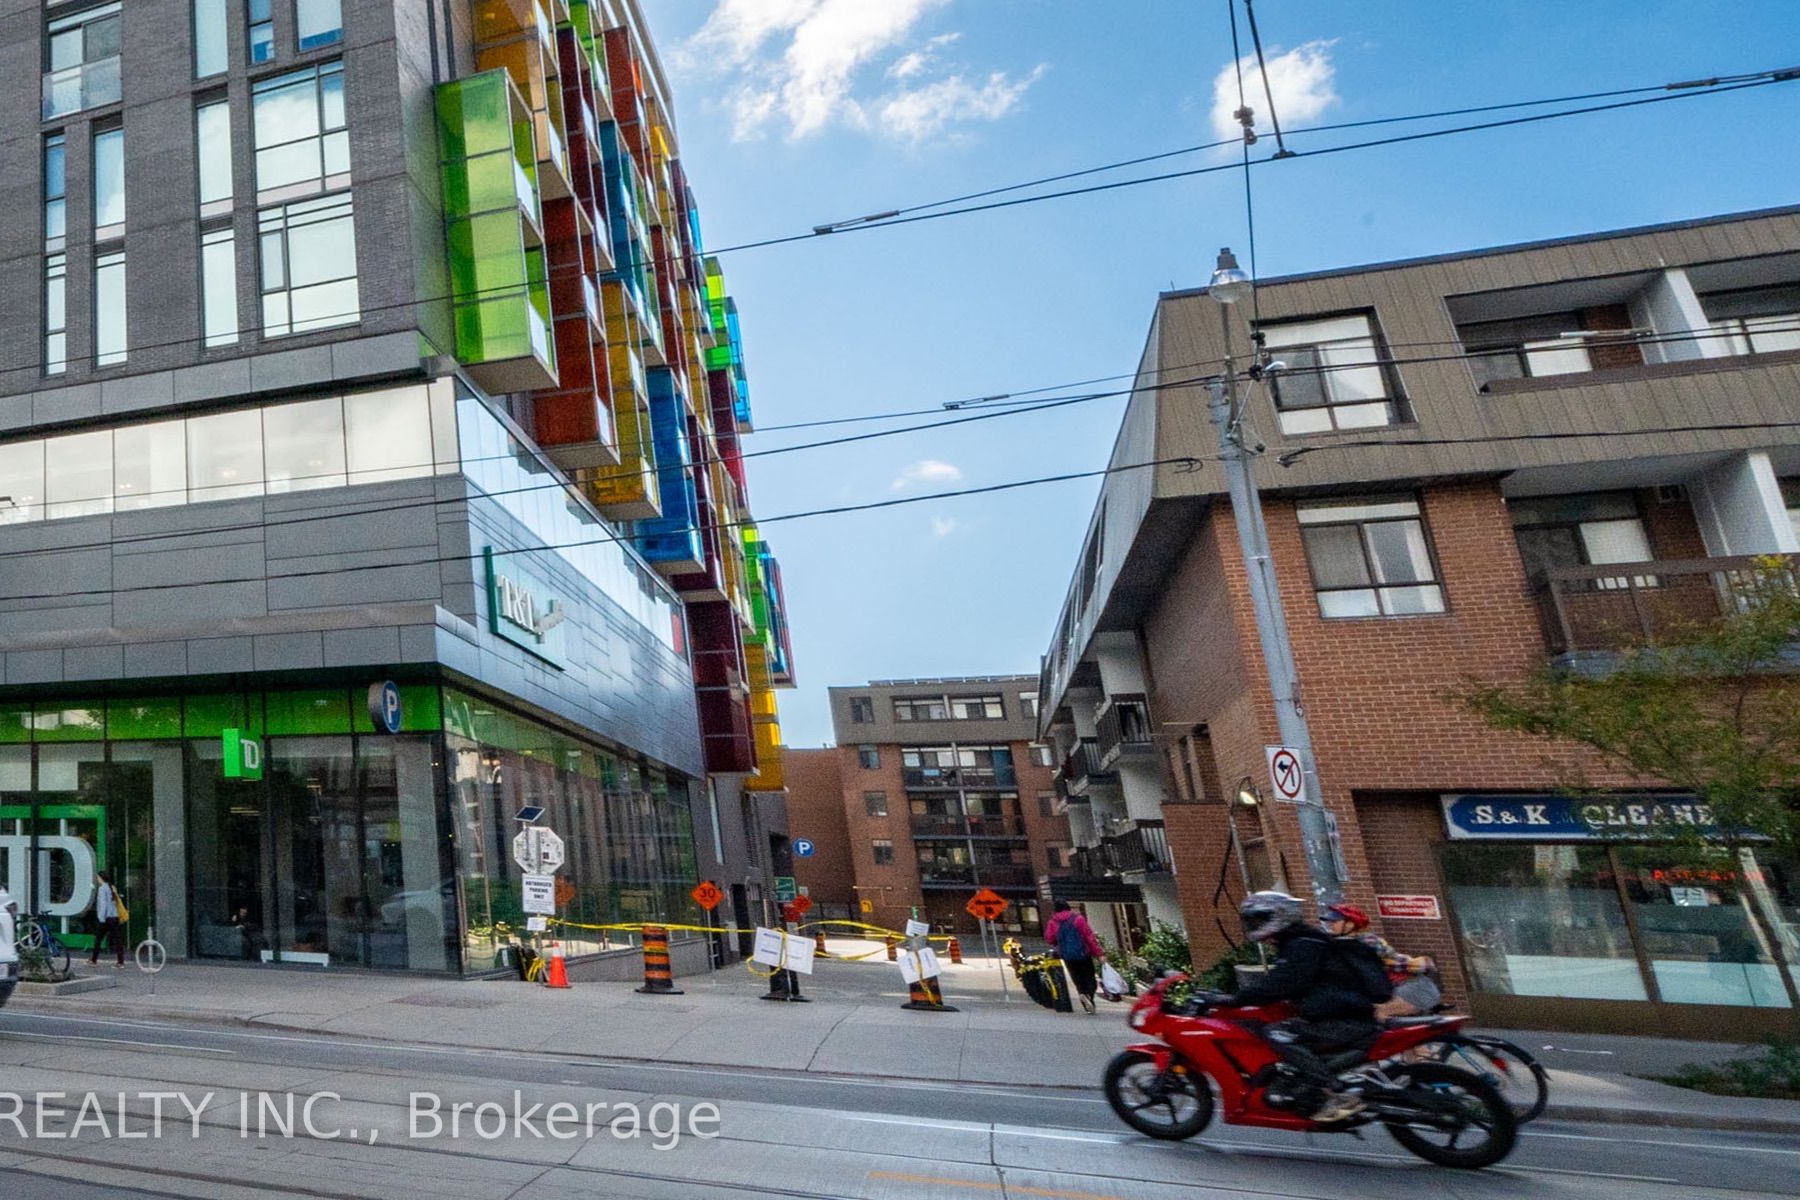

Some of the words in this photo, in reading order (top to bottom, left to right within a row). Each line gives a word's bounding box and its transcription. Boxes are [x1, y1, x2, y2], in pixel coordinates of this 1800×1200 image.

[494, 575, 536, 633] T&T
[386, 690, 398, 724] P
[240, 738, 260, 770] TD
[799, 841, 811, 855] P
[700, 887, 716, 899] 30
